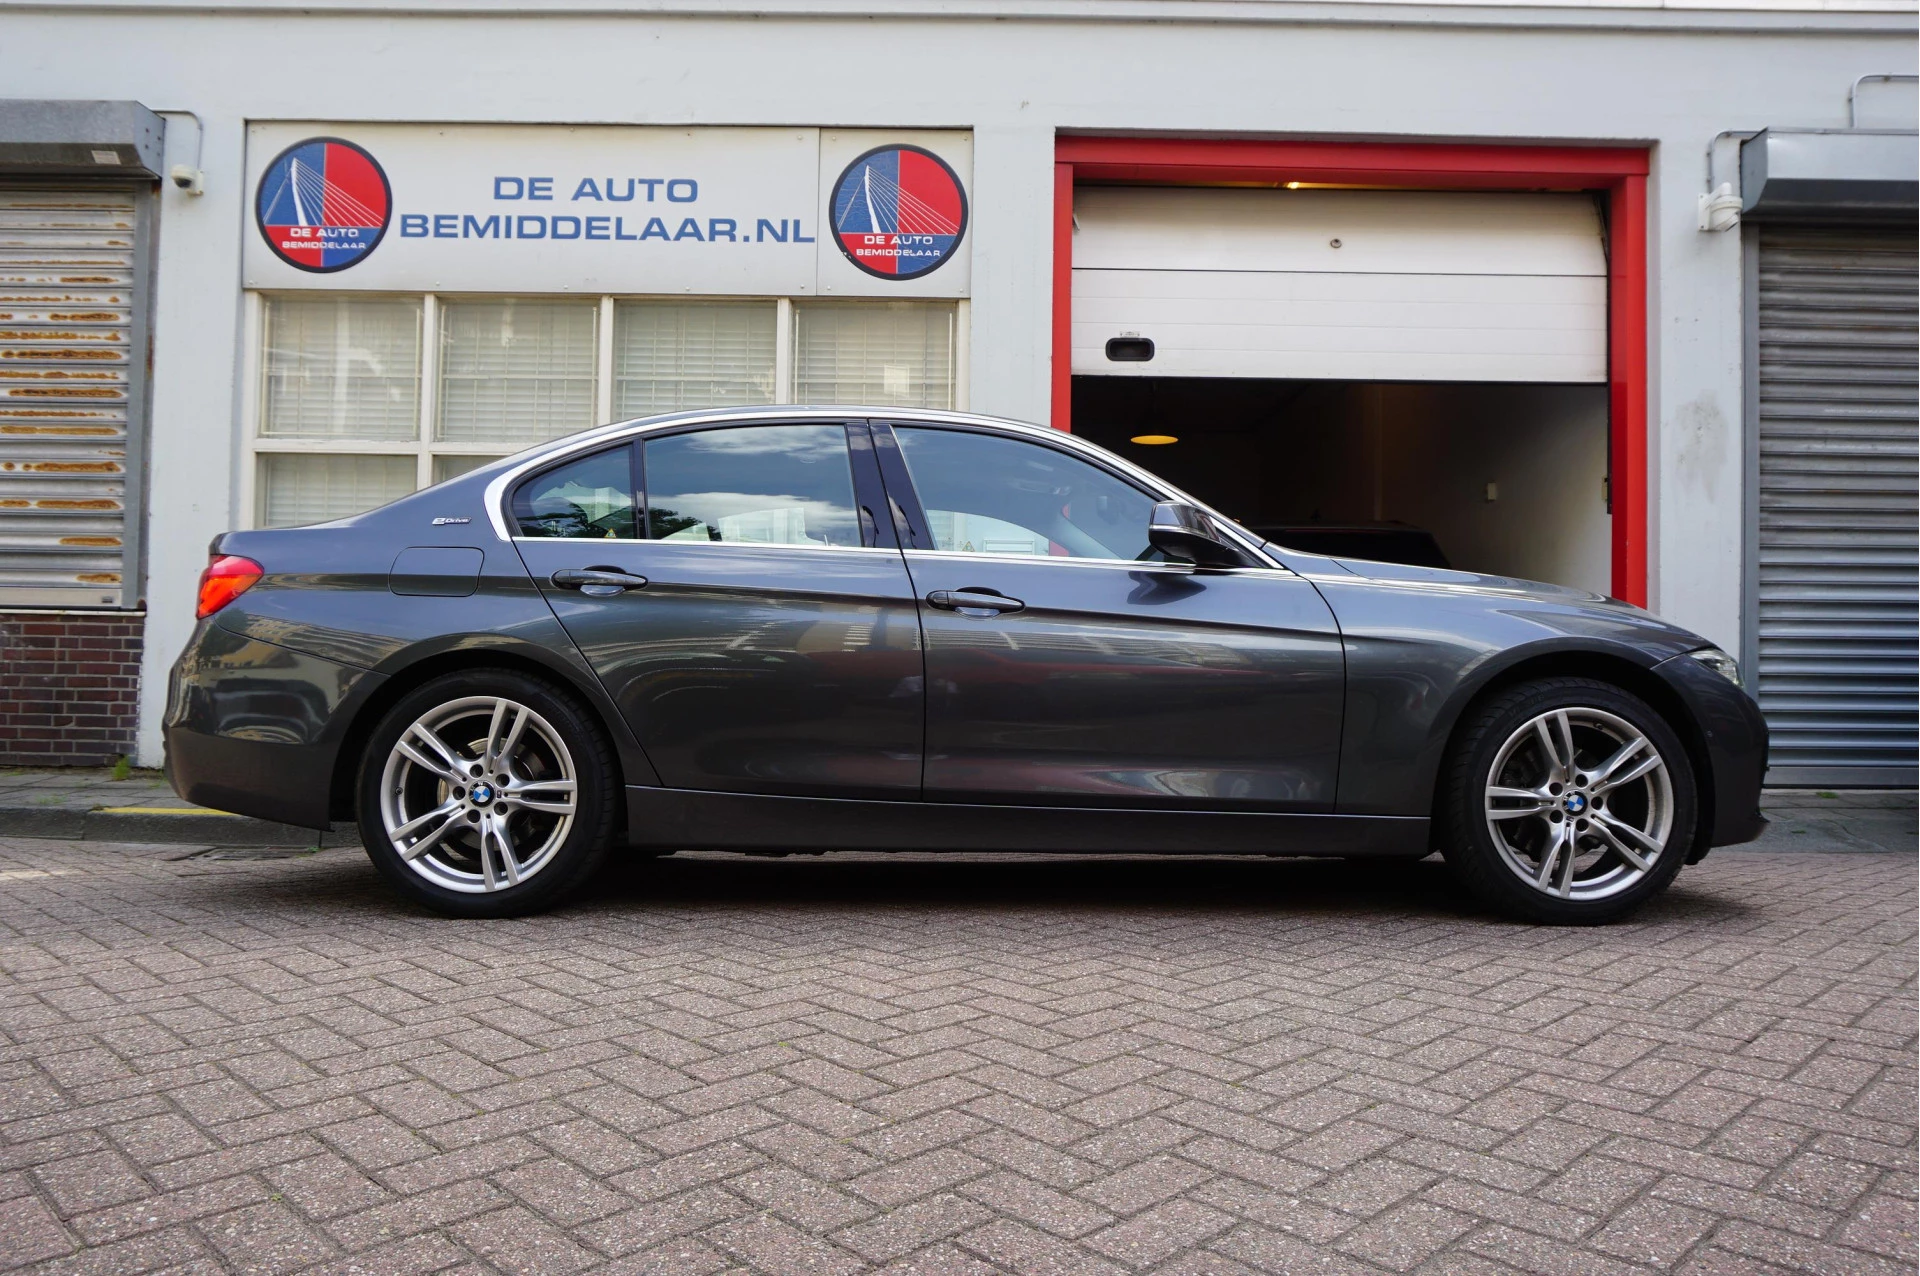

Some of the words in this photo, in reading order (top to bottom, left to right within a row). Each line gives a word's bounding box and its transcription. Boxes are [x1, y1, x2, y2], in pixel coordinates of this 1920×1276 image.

[493, 176, 554, 201] DE
[571, 177, 699, 203] AUTO
[290, 228, 312, 238] DE
[316, 228, 359, 238] AUTO
[399, 213, 816, 243] BEMIDDELAAR.NL
[282, 241, 366, 249] BEMIDDELAAR
[864, 235, 886, 245] DE
[890, 235, 933, 245] AUTO
[856, 248, 941, 257] BEMIDDELAAR
